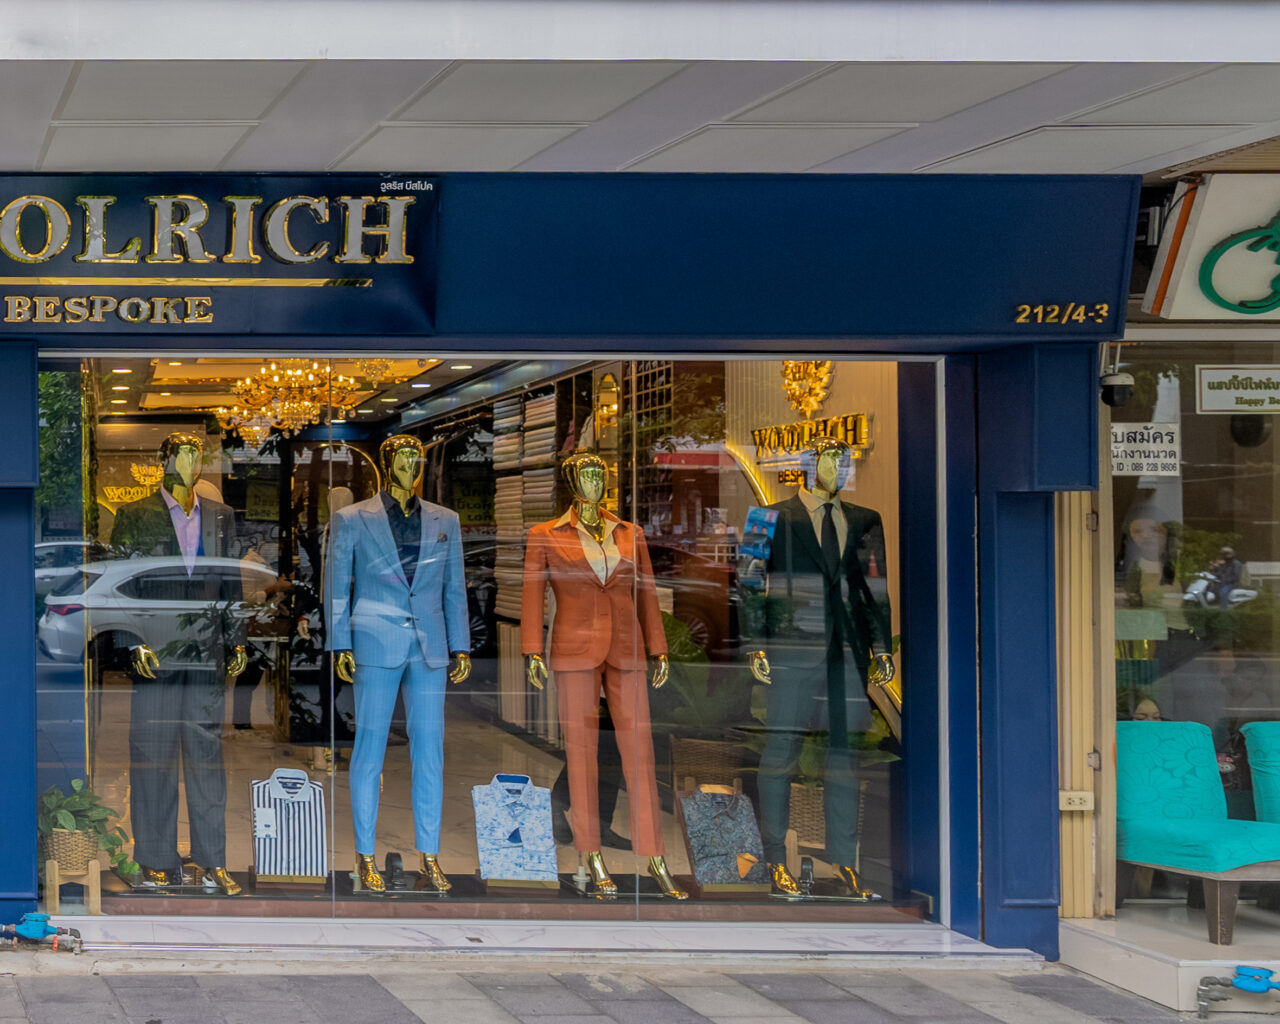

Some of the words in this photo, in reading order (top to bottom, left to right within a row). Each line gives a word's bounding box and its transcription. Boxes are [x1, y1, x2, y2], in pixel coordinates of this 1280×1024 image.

[4, 296, 214, 324] BESPOKE
[1016, 302, 1109, 324] 212/4-3
[1116, 462, 1124, 472] ID
